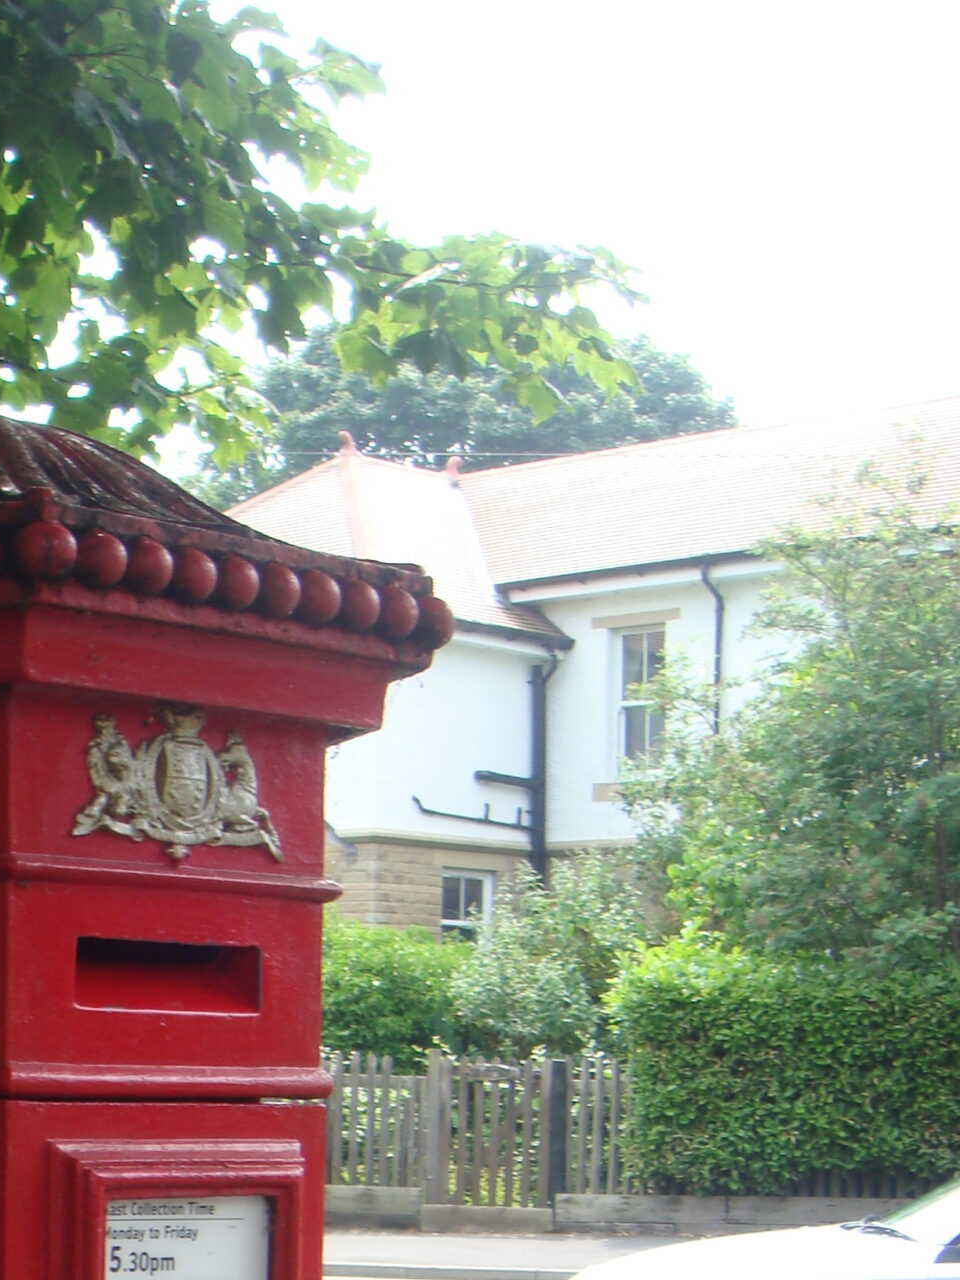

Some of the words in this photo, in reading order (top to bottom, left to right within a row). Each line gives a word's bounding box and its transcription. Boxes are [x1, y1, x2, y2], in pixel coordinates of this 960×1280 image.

[130, 1201, 185, 1216] Collection
[187, 1200, 216, 1215] Time
[149, 1227, 160, 1240] to
[164, 1225, 199, 1242] Friday
[109, 1245, 176, 1275] 5.30pm
